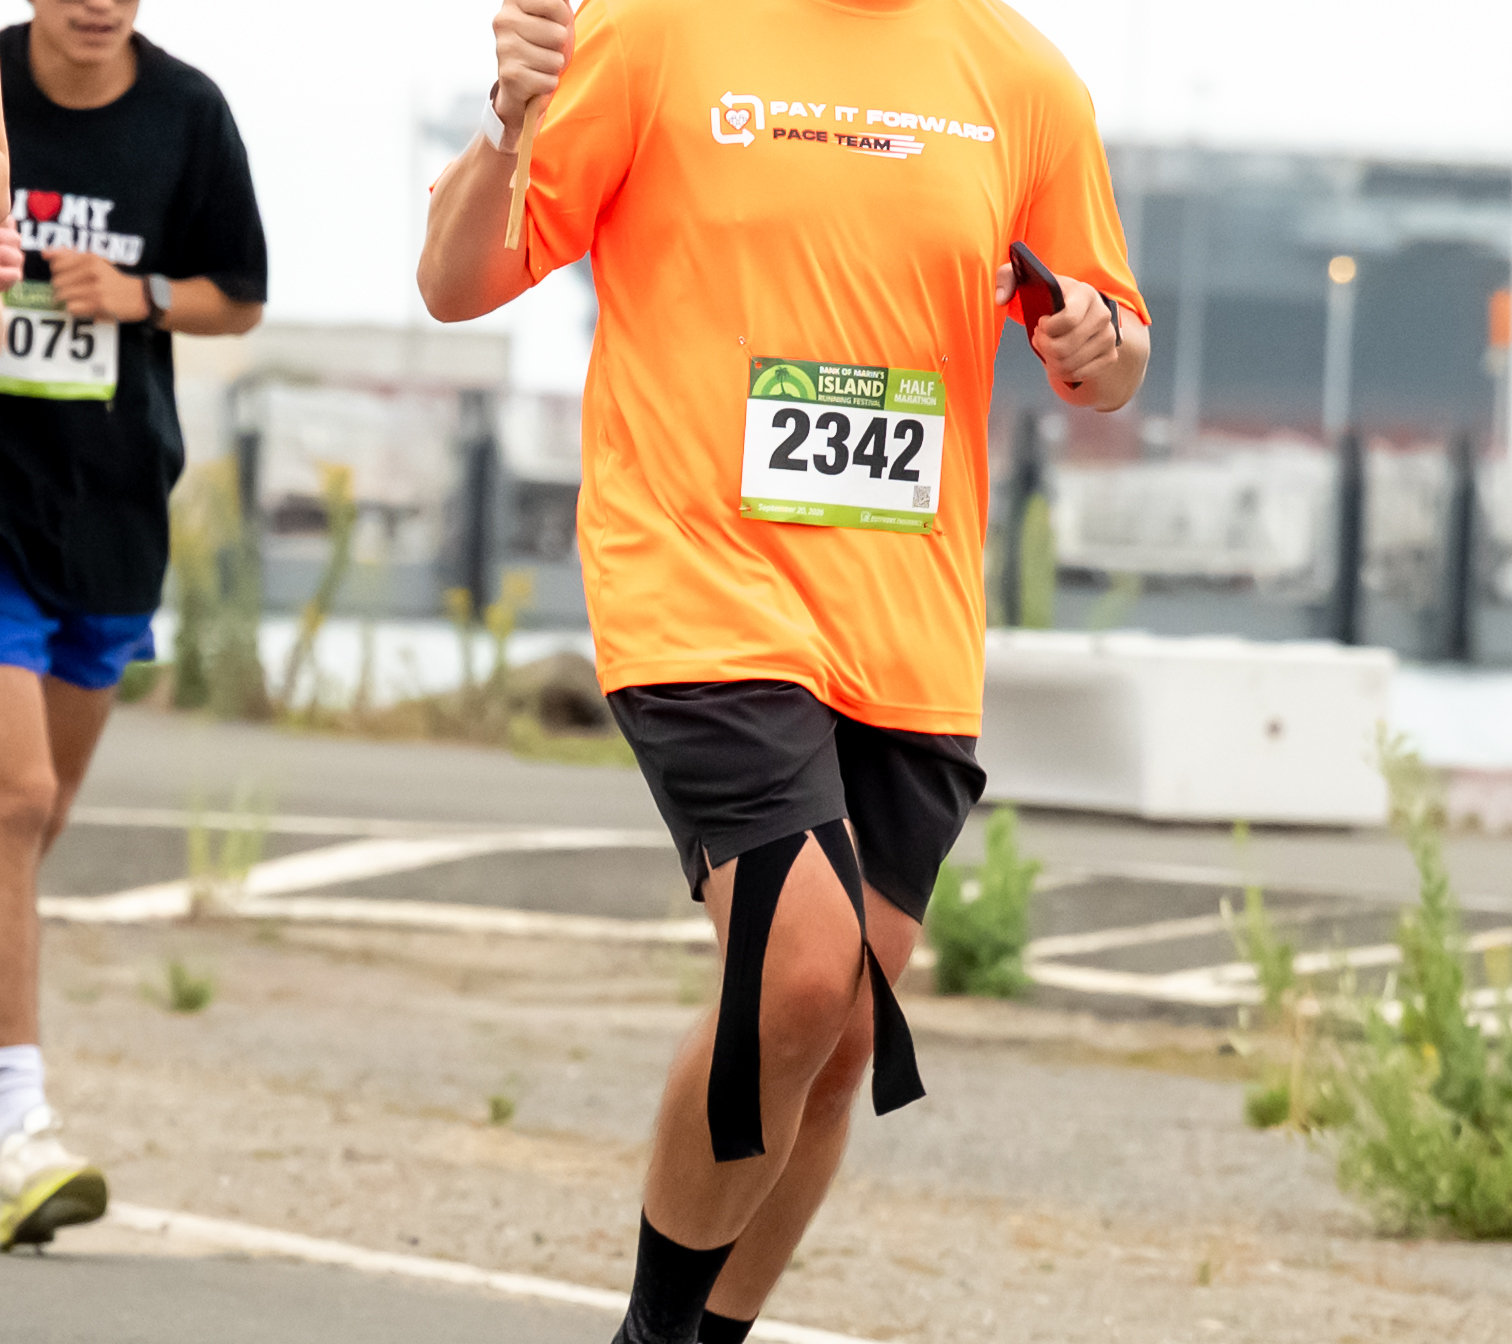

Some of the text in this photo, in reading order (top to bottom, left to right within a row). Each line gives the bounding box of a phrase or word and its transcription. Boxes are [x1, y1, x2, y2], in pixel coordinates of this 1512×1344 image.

[770, 100, 995, 142] PAY IT FORWARD
[773, 128, 891, 151] PACE TEAM
[57, 193, 116, 231] MY
[8, 316, 95, 361] 075
[819, 366, 840, 376] BANK
[841, 367, 852, 376] OF
[818, 375, 885, 397] ISLAND
[899, 378, 935, 397] HALF
[818, 394, 881, 408] RUNNING FESTIVAL
[894, 393, 937, 406] MARATHON
[769, 408, 925, 482] 2342
